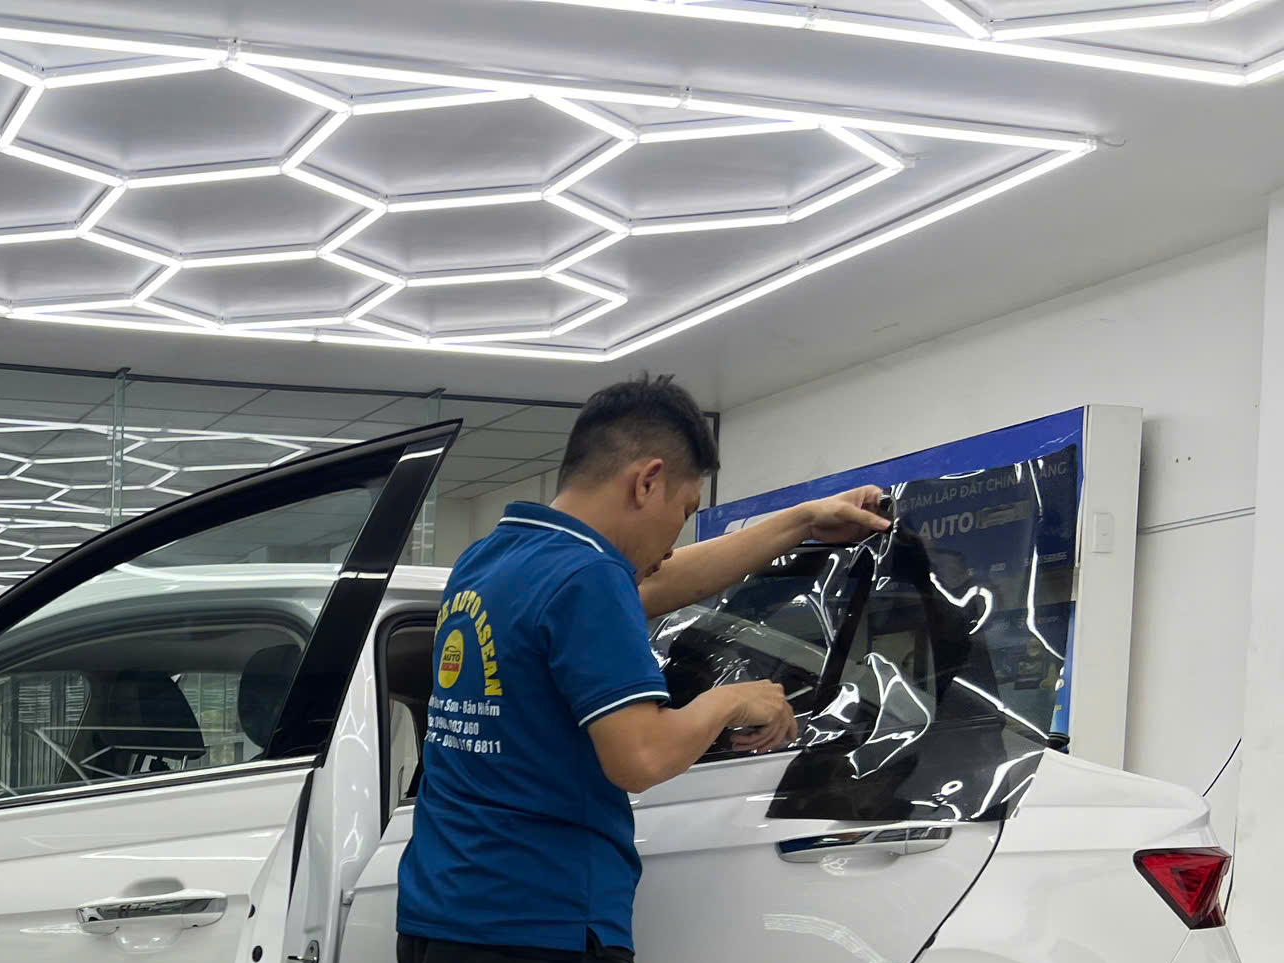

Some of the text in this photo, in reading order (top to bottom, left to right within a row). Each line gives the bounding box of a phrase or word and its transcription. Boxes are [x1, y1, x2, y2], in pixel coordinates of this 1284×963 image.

[918, 512, 974, 540] AUTO
[450, 590, 503, 696] AUTO ASEAN
[443, 654, 460, 662] AUTO
[474, 740, 501, 753] 6811
